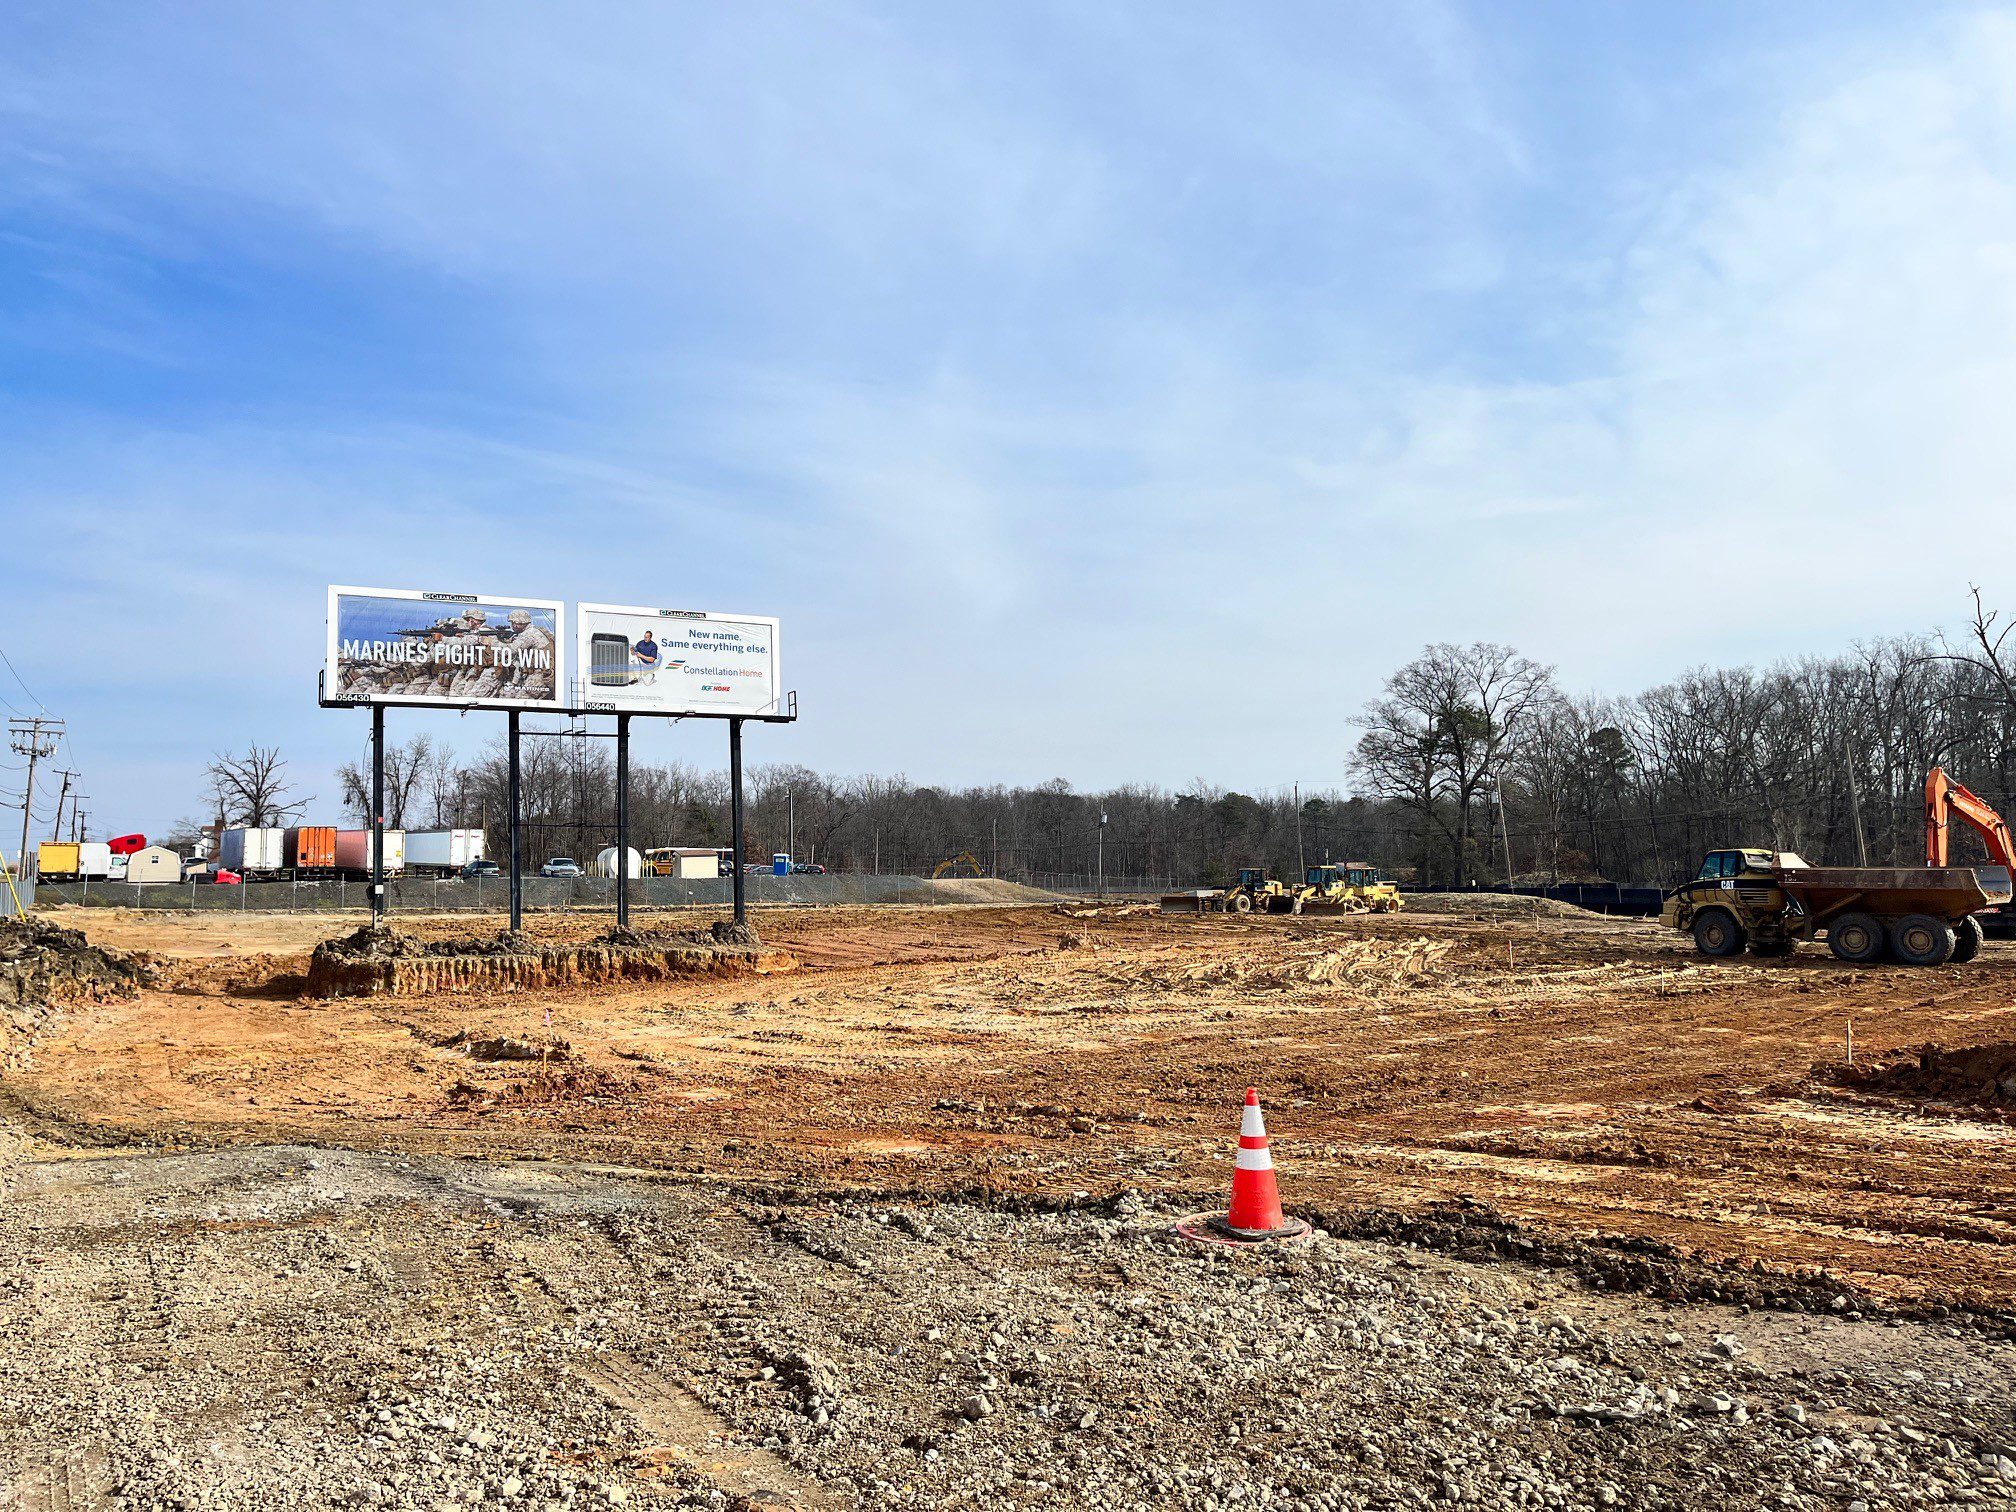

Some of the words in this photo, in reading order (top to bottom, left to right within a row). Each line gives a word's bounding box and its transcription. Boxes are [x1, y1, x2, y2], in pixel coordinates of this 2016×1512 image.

[688, 629, 711, 639] New
[712, 632, 742, 641] name.
[661, 638, 690, 649] Same
[692, 641, 744, 654] everything
[746, 644, 768, 654] else.
[343, 639, 428, 663] MARINES
[434, 643, 486, 666] FIGHT
[491, 646, 512, 668] TO
[518, 648, 551, 670] WIN
[683, 665, 739, 677] Constellation
[739, 668, 763, 678] Home
[336, 694, 370, 702] 056430
[586, 702, 616, 711] 056440
[1720, 880, 1735, 890] CAT
